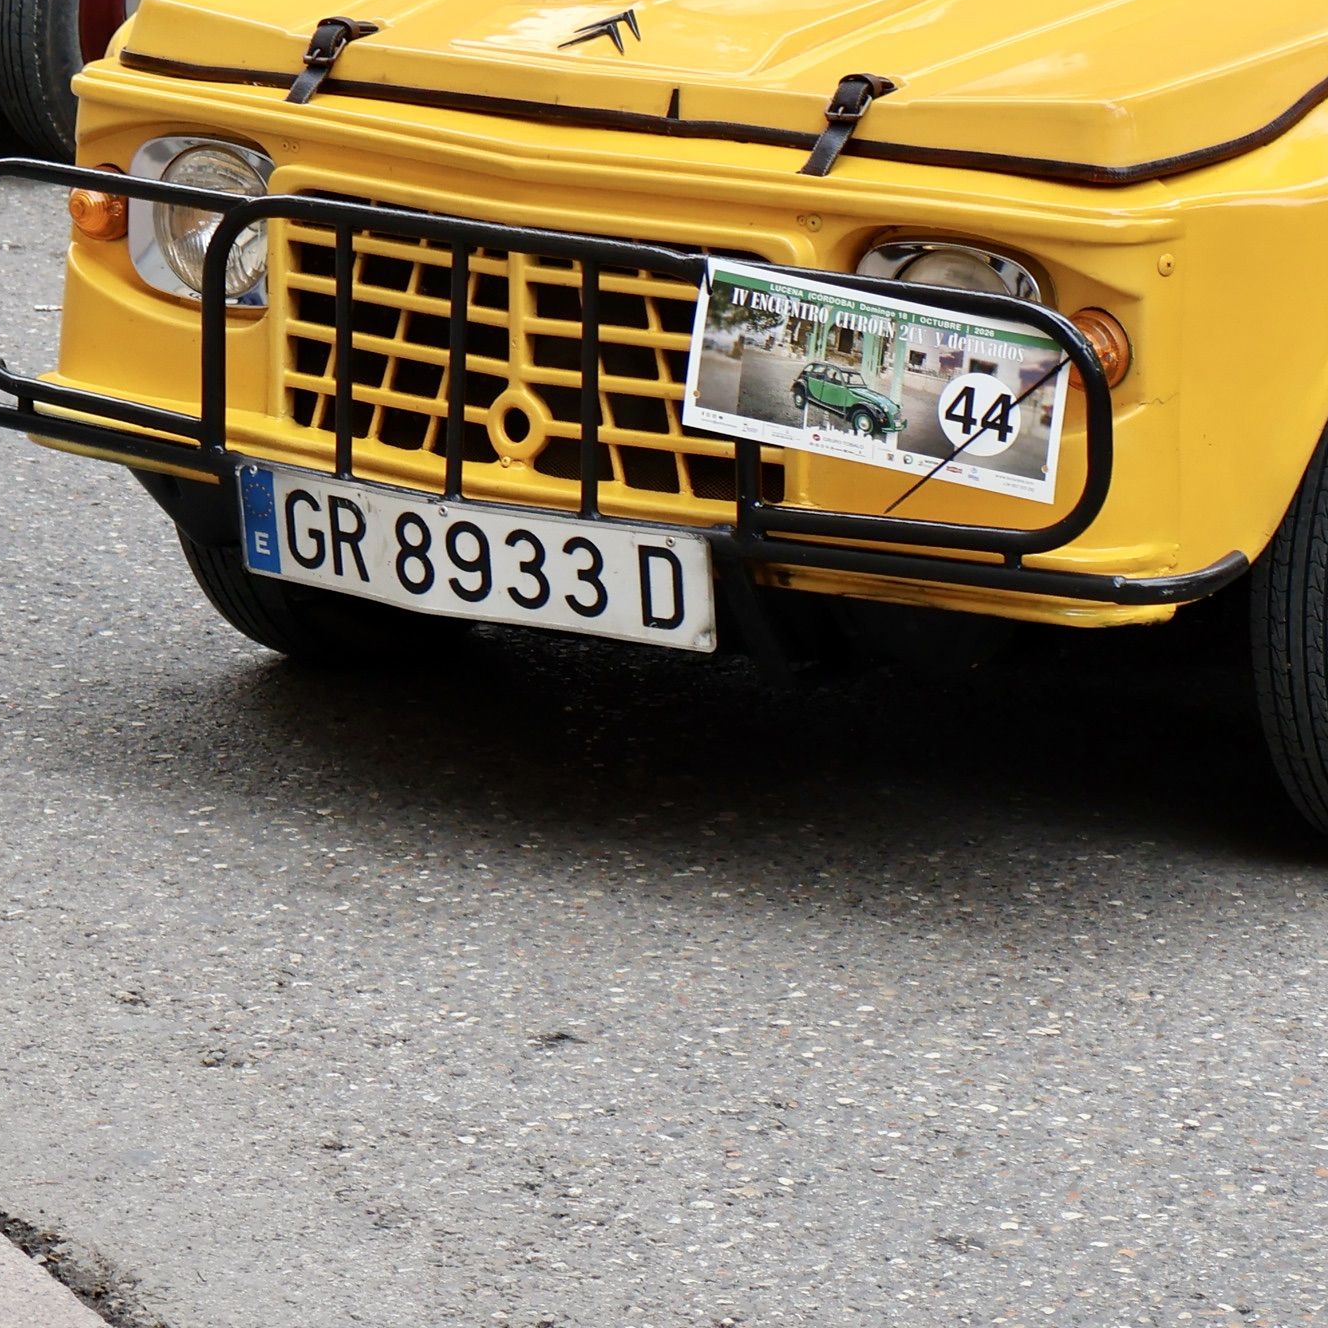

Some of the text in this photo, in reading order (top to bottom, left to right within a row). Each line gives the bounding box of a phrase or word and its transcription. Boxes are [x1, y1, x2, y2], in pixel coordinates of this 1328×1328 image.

[731, 287, 749, 307] IV
[751, 290, 830, 324] ENCUENTRO
[898, 324, 927, 345] 2CV
[934, 329, 944, 348] y
[947, 332, 1025, 364] derivados
[769, 283, 804, 298] LUCENA
[859, 304, 896, 319] Domingo
[919, 316, 962, 332] OCTUBRE
[945, 386, 1014, 443] 44
[254, 529, 272, 557] E
[284, 488, 686, 631] GR 8933 D
